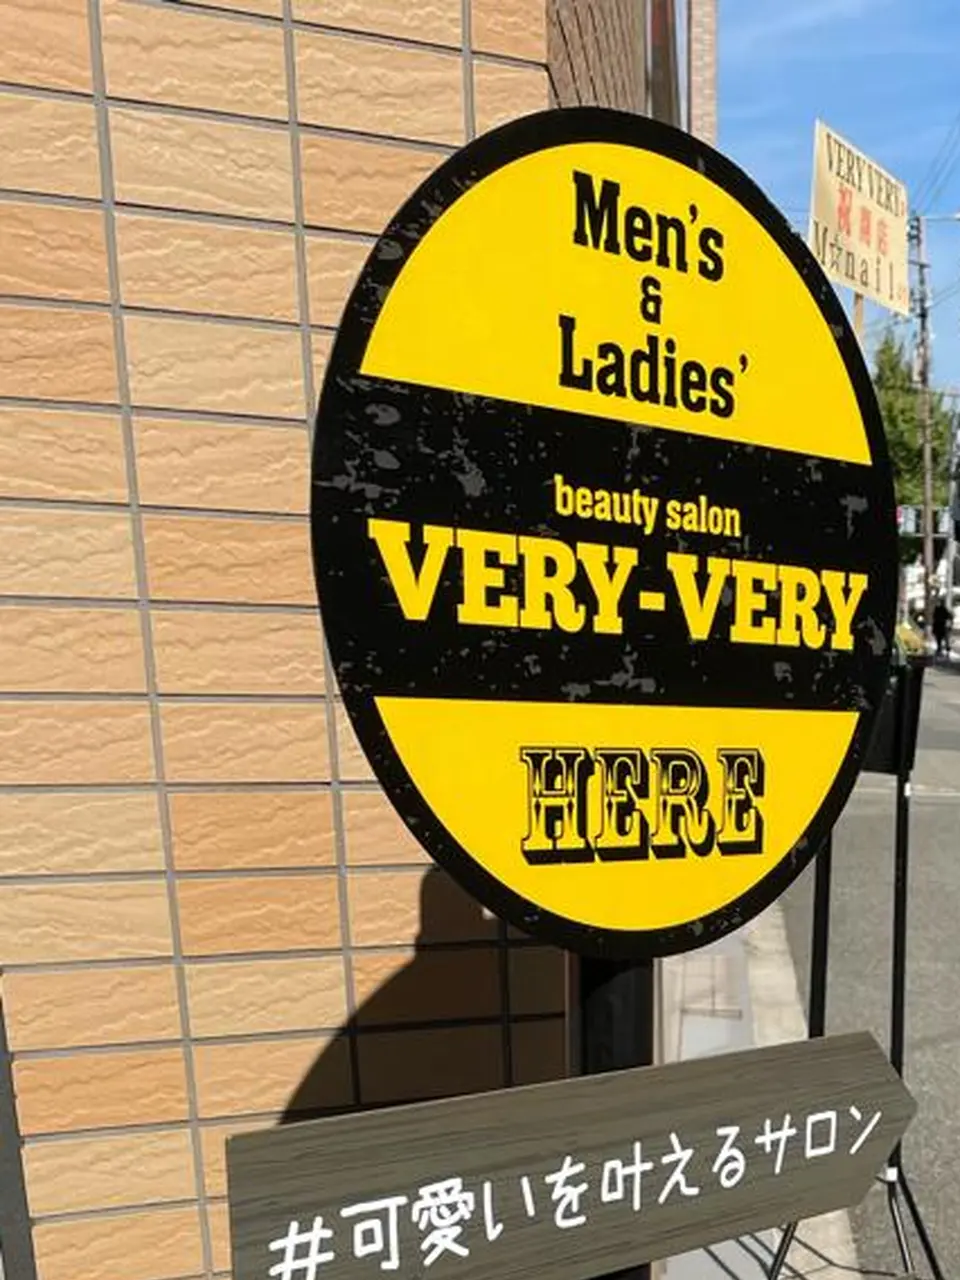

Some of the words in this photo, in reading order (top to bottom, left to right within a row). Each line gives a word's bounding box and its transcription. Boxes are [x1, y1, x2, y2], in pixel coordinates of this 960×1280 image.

[572, 171, 725, 282] Men's
[826, 132, 867, 192] VERY
[866, 163, 903, 218] VERY
[640, 276, 662, 324] &
[559, 315, 750, 418] Ladies'
[554, 474, 659, 536] beauty
[666, 495, 742, 537] salon
[368, 518, 868, 651] VERY-VERY
[520, 746, 765, 864] HERE
